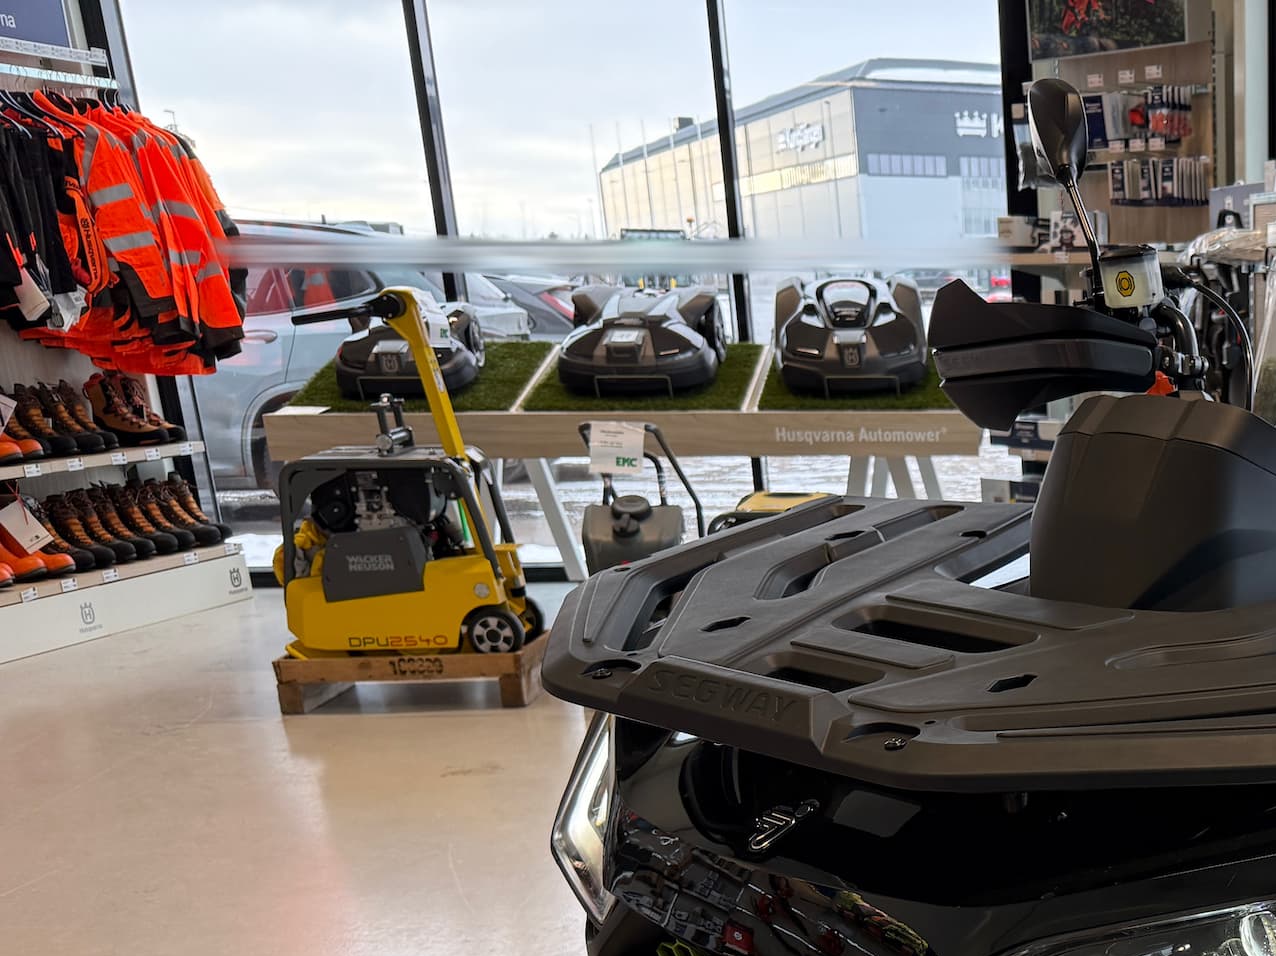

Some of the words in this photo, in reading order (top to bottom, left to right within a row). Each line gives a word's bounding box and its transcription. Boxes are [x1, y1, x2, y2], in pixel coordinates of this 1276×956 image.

[775, 427, 854, 445] Husqvarna
[616, 457, 638, 468] EMC
[346, 554, 393, 563] WACKER
[348, 562, 395, 571] NEUSON
[348, 634, 449, 649] DPU2540
[650, 670, 798, 721] SEGWAY
